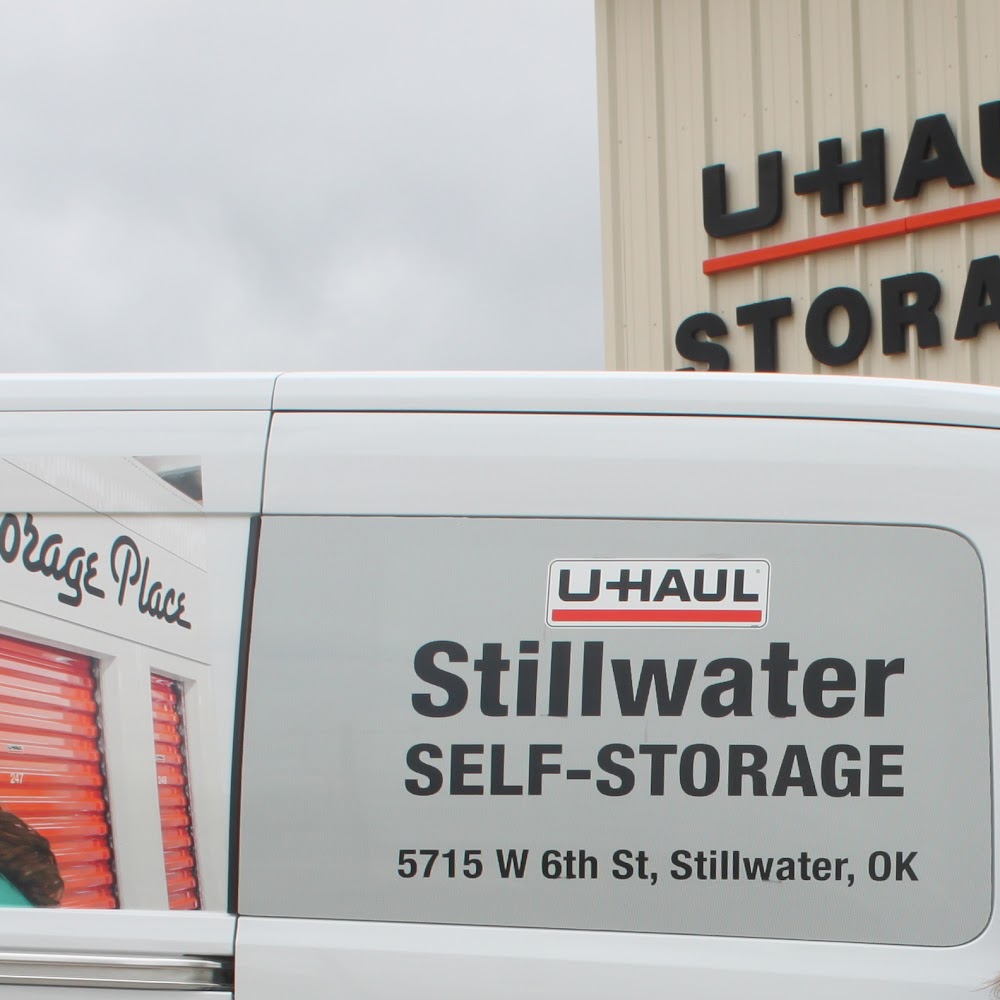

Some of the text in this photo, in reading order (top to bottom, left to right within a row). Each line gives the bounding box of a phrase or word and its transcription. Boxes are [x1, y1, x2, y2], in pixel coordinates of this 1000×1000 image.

[110, 535, 191, 629] Place
[558, 569, 759, 602] U-HAUL
[411, 640, 905, 718] Stillwater
[404, 743, 905, 798] SELF-STORAGE
[397, 848, 919, 887] 5715 W 6th St, Stillwater, OK
